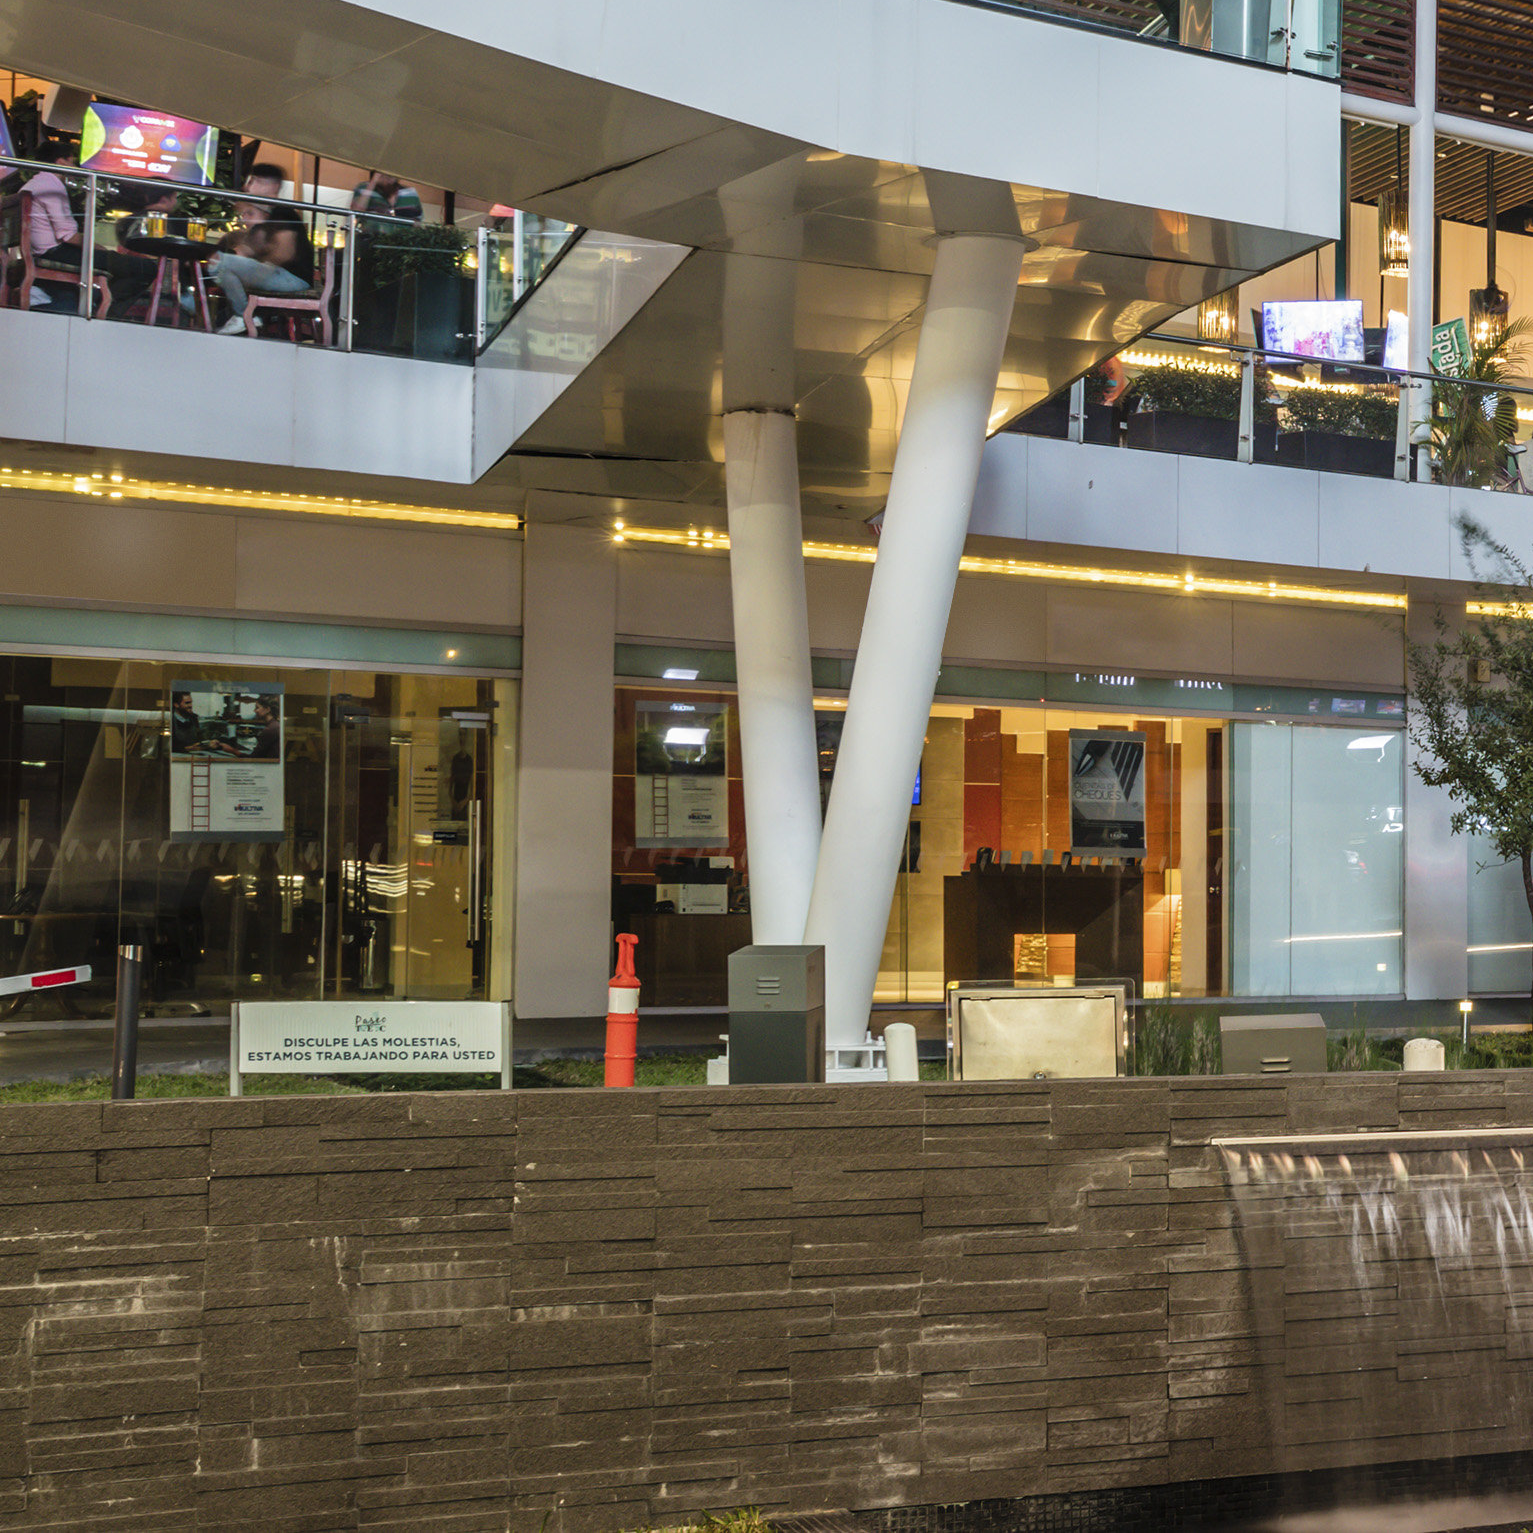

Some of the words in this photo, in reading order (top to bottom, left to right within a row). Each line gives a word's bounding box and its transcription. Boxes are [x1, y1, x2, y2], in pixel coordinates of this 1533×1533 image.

[1074, 789, 1122, 801] CHEQUES
[355, 1015, 387, 1026] Paseo
[284, 1038, 349, 1047] DISCULPE
[353, 1038, 379, 1047] LAS
[382, 1037, 461, 1048] MOLESTIAS,
[248, 1051, 312, 1061] ESTAMOS
[317, 1051, 409, 1061] TRABAJANDO
[412, 1051, 450, 1060] PARA
[453, 1050, 496, 1060] USTED
